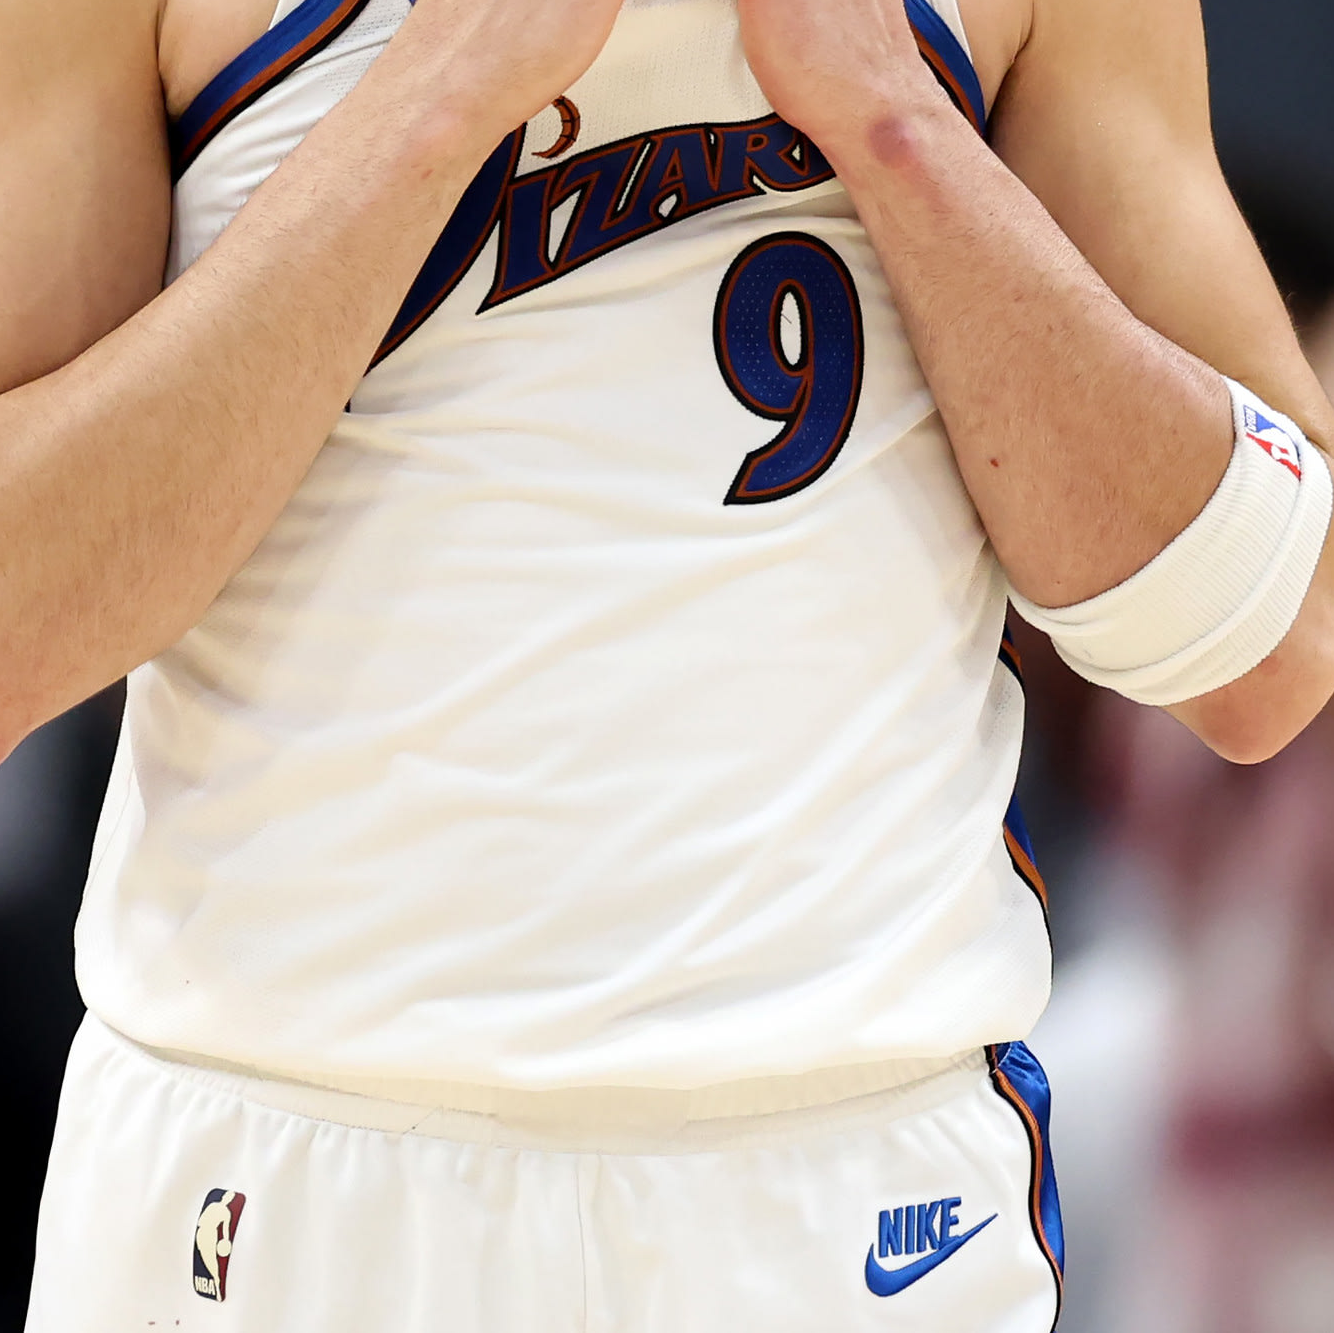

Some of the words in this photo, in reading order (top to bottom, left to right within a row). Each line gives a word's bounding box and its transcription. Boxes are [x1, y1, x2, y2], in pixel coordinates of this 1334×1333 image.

[361, 110, 837, 377] IZAR
[713, 231, 864, 505] 9
[194, 1275, 216, 1296] NBA
[878, 1196, 962, 1258] NIKE
